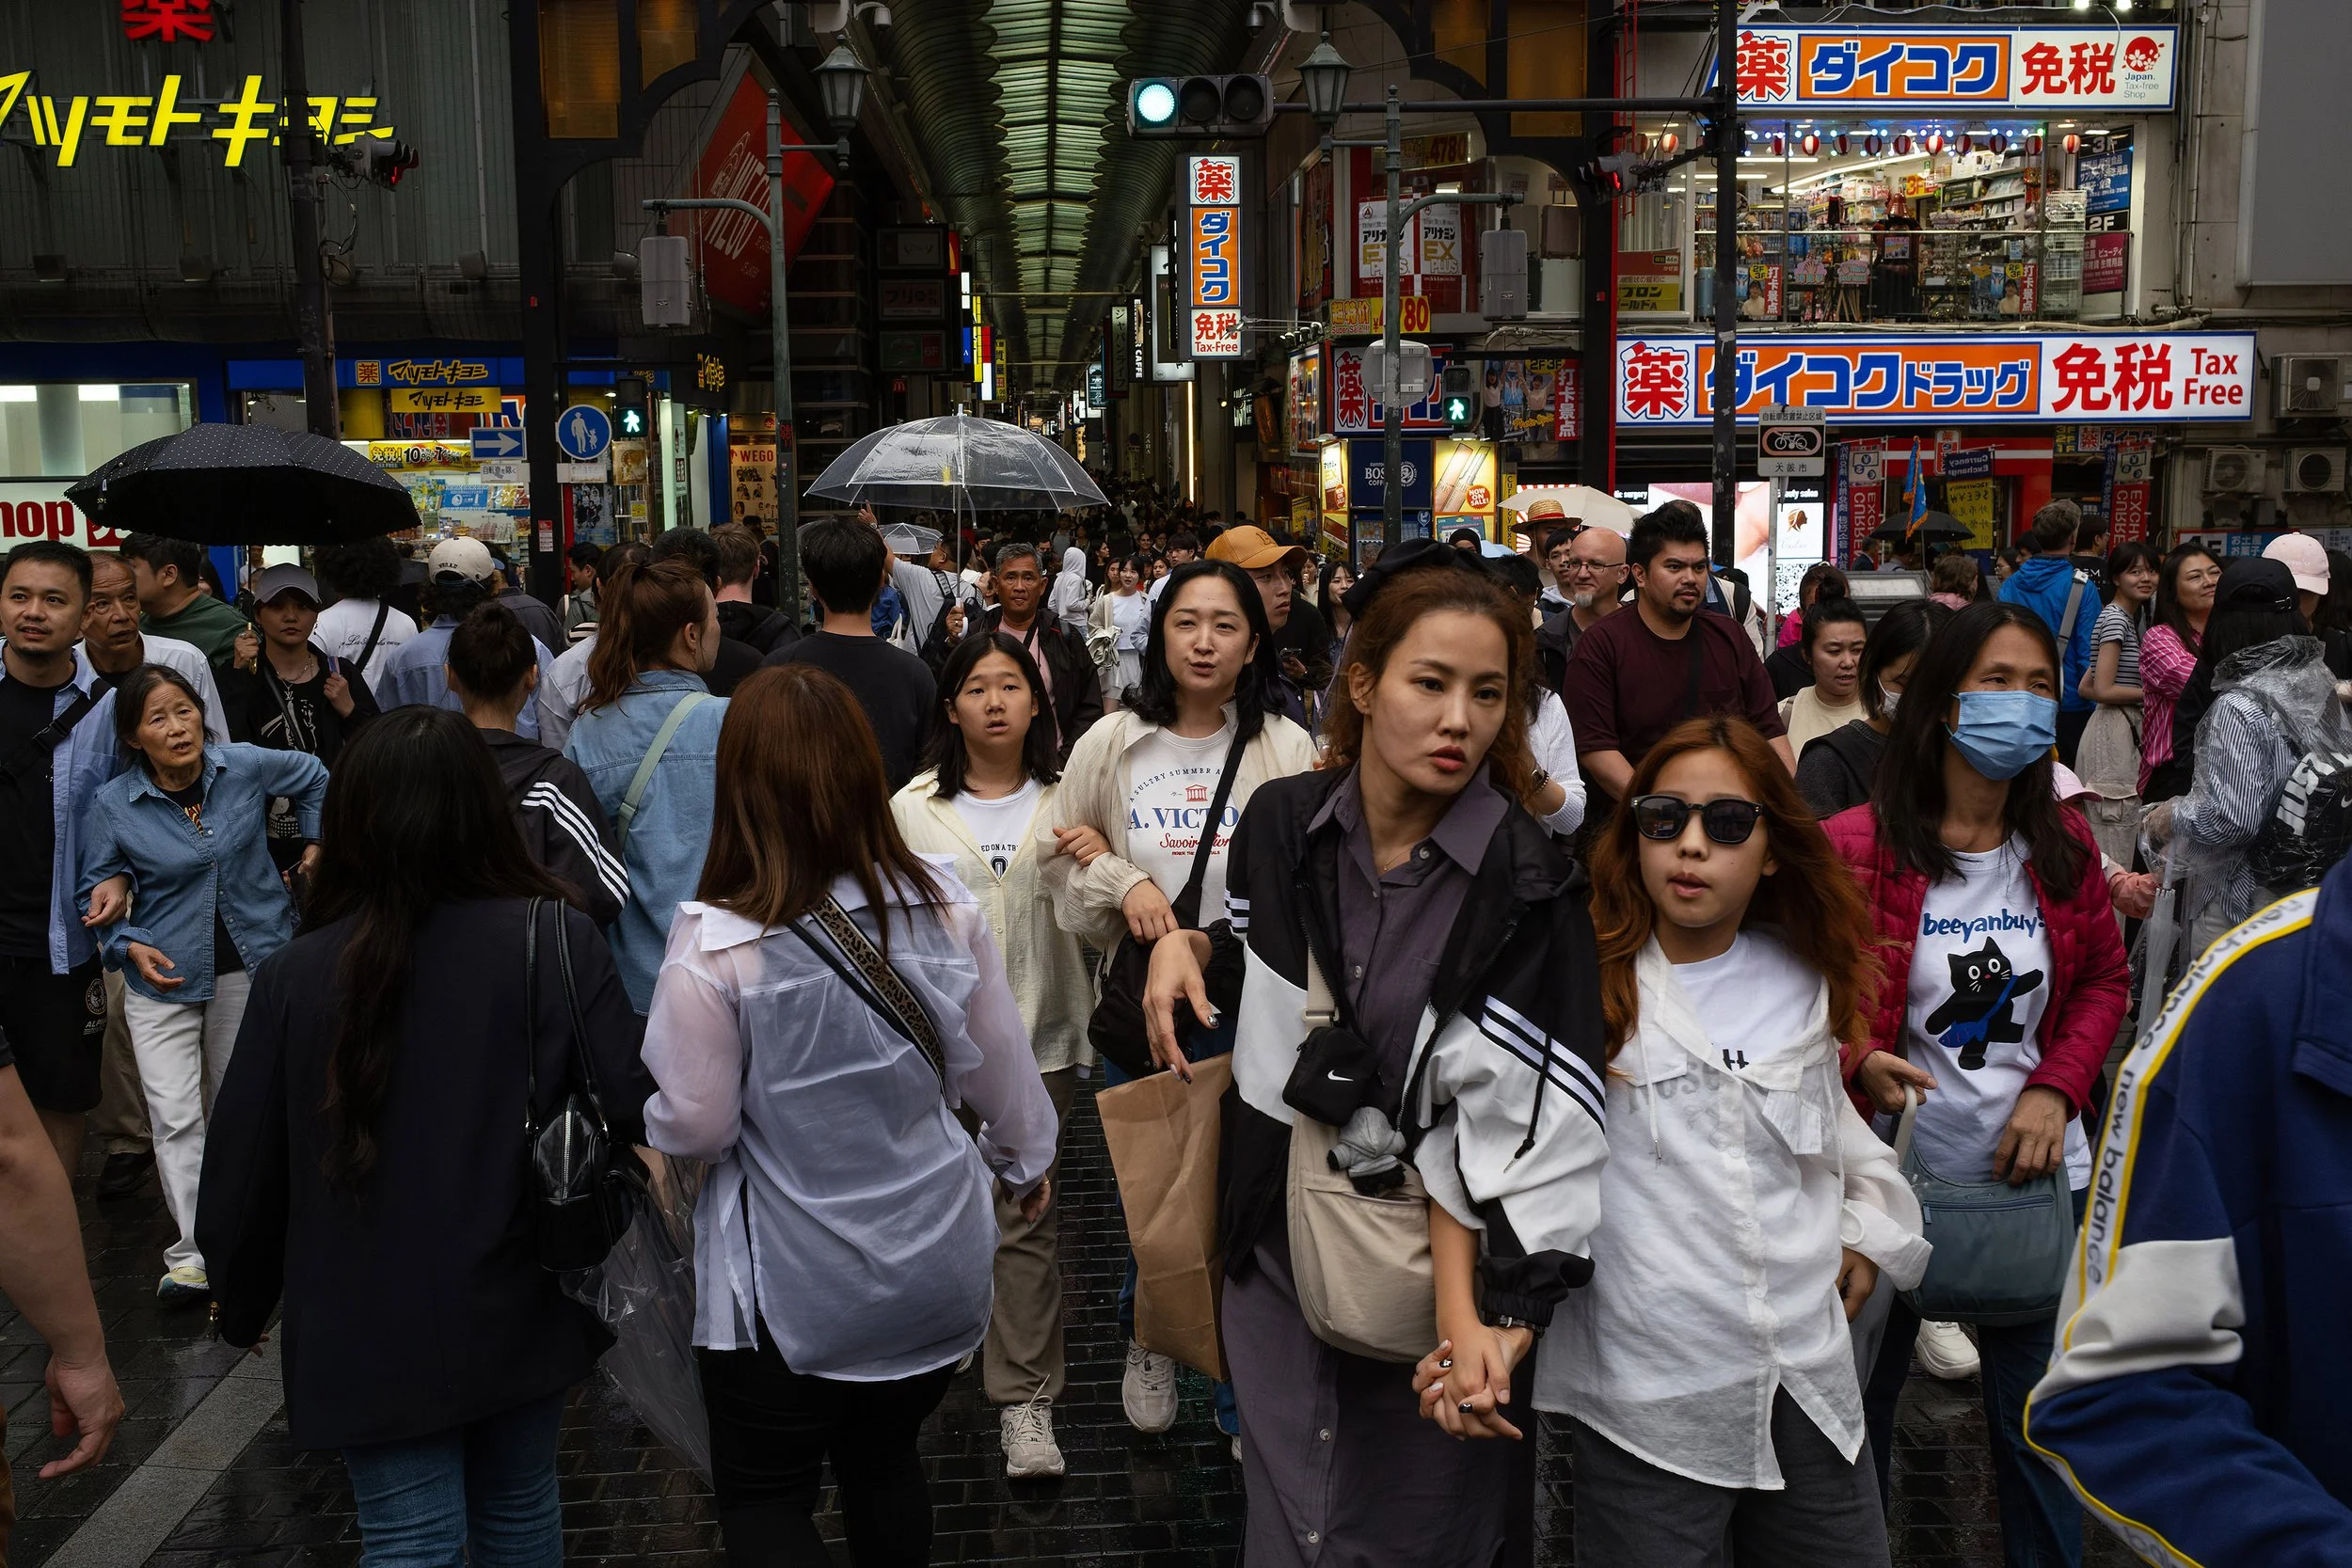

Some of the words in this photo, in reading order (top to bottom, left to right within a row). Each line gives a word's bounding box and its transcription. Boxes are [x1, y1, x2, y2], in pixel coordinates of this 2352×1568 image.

[1811, 41, 1998, 93] ダイコク
[2020, 41, 2116, 95] 免税
[2124, 72, 2155, 82] Japan.
[2123, 89, 2146, 99] Shop
[2092, 136, 2117, 153] 3F
[1197, 158, 1232, 201] 薬
[1423, 227, 1455, 241] アリナミン
[2090, 215, 2115, 231] 2F
[1200, 212, 1231, 303] ダイコク
[1423, 241, 1455, 261] EX
[1195, 312, 1238, 340] 免税
[1195, 341, 1238, 353] Tax-Free
[357, 361, 380, 384] 薬
[389, 360, 487, 384] マツモトキヨシ
[2191, 347, 2238, 375] Tax
[1628, 341, 1684, 415] 薬
[1708, 352, 2029, 409] ダイコクドラッグ
[2052, 342, 2172, 412] 免税
[408, 390, 485, 410] マツモトキヨシ
[1559, 368, 1576, 437] 打卡景点
[2184, 378, 2243, 405] Free
[740, 450, 773, 463] WEGO
[1365, 467, 1385, 480] BOS
[1470, 498, 1489, 506] SALE!
[1134, 772, 1166, 796] SULTRY
[1169, 768, 1212, 777] SUMMER
[2110, 1069, 2135, 1140] new
[2086, 1148, 2124, 1286] balance
